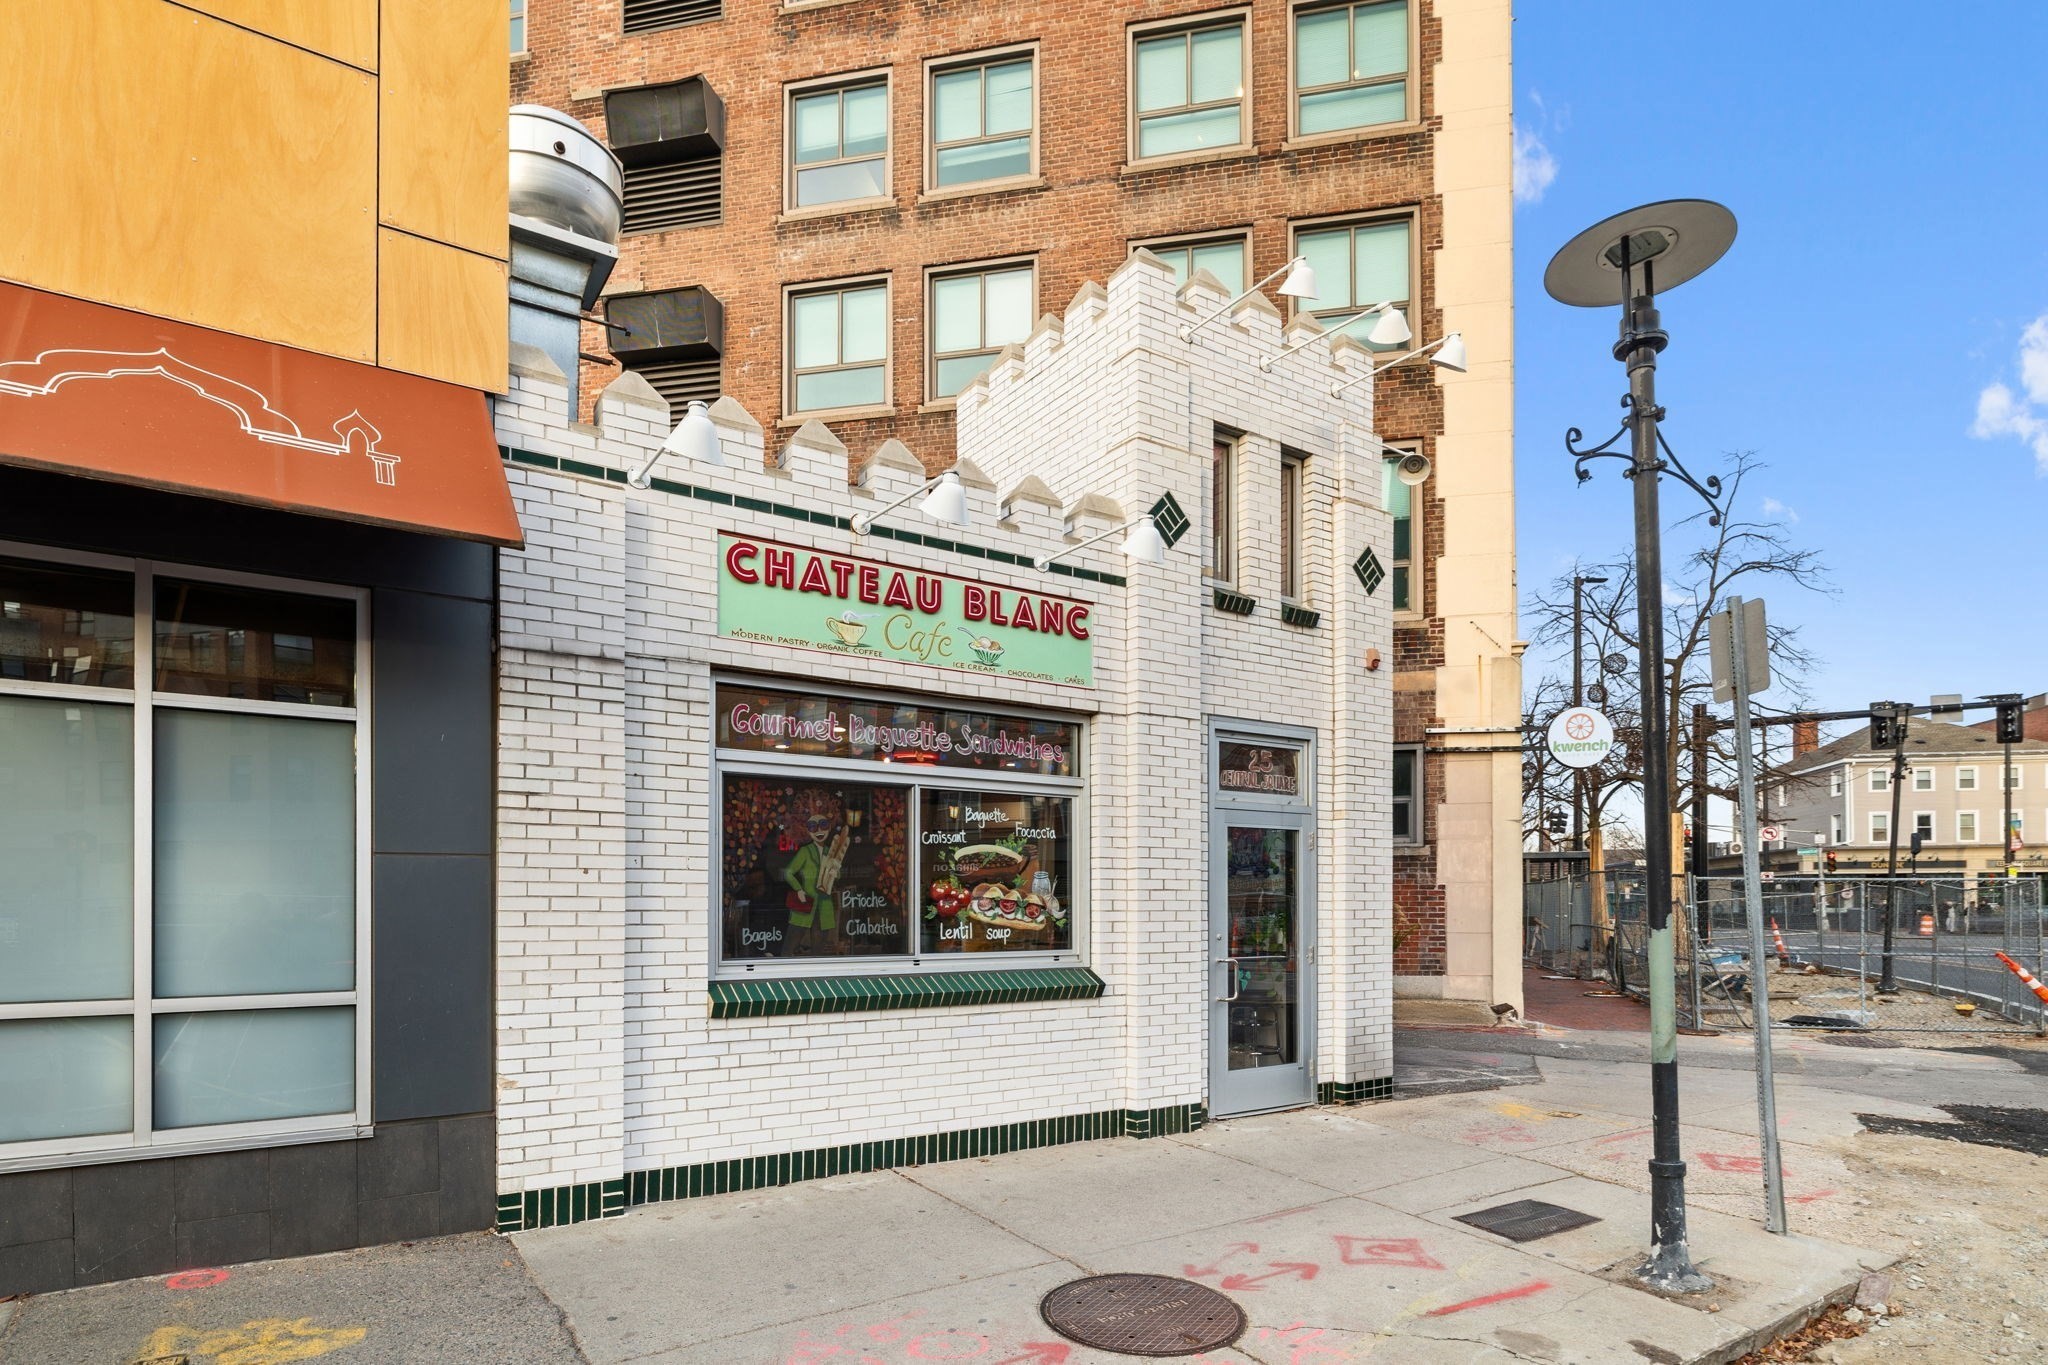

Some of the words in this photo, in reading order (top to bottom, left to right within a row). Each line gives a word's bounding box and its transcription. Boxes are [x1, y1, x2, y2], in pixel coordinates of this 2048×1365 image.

[726, 541, 942, 615] CHATEAU
[963, 585, 1090, 640] BLANC
[731, 629, 773, 643] MODERN
[777, 636, 810, 648] PASTRY
[816, 642, 850, 654] ORGANIC
[852, 647, 884, 659] COFFEE
[884, 613, 953, 661] Cafe
[952, 661, 966, 670] ICE
[967, 662, 996, 674] CREAM
[1006, 668, 1054, 682] CHOCOLATES
[1063, 676, 1086, 686] CAKES
[730, 703, 844, 744] Gourmet
[848, 714, 953, 753] Baguette
[954, 724, 1065, 763] Sandwiches
[1553, 739, 1609, 753] kwench
[1248, 749, 1274, 773] 25
[1220, 768, 1261, 789] CENTRAL
[1261, 773, 1297, 793] SQUARE
[965, 806, 1010, 829] Baguette
[921, 830, 967, 845] Croissant
[1014, 820, 1057, 840] Focaccia
[841, 890, 888, 908] Brioche
[741, 926, 783, 951] Bagels
[845, 918, 898, 936] Ciabatta
[940, 922, 974, 941] Lentil
[985, 926, 1011, 945] soup
